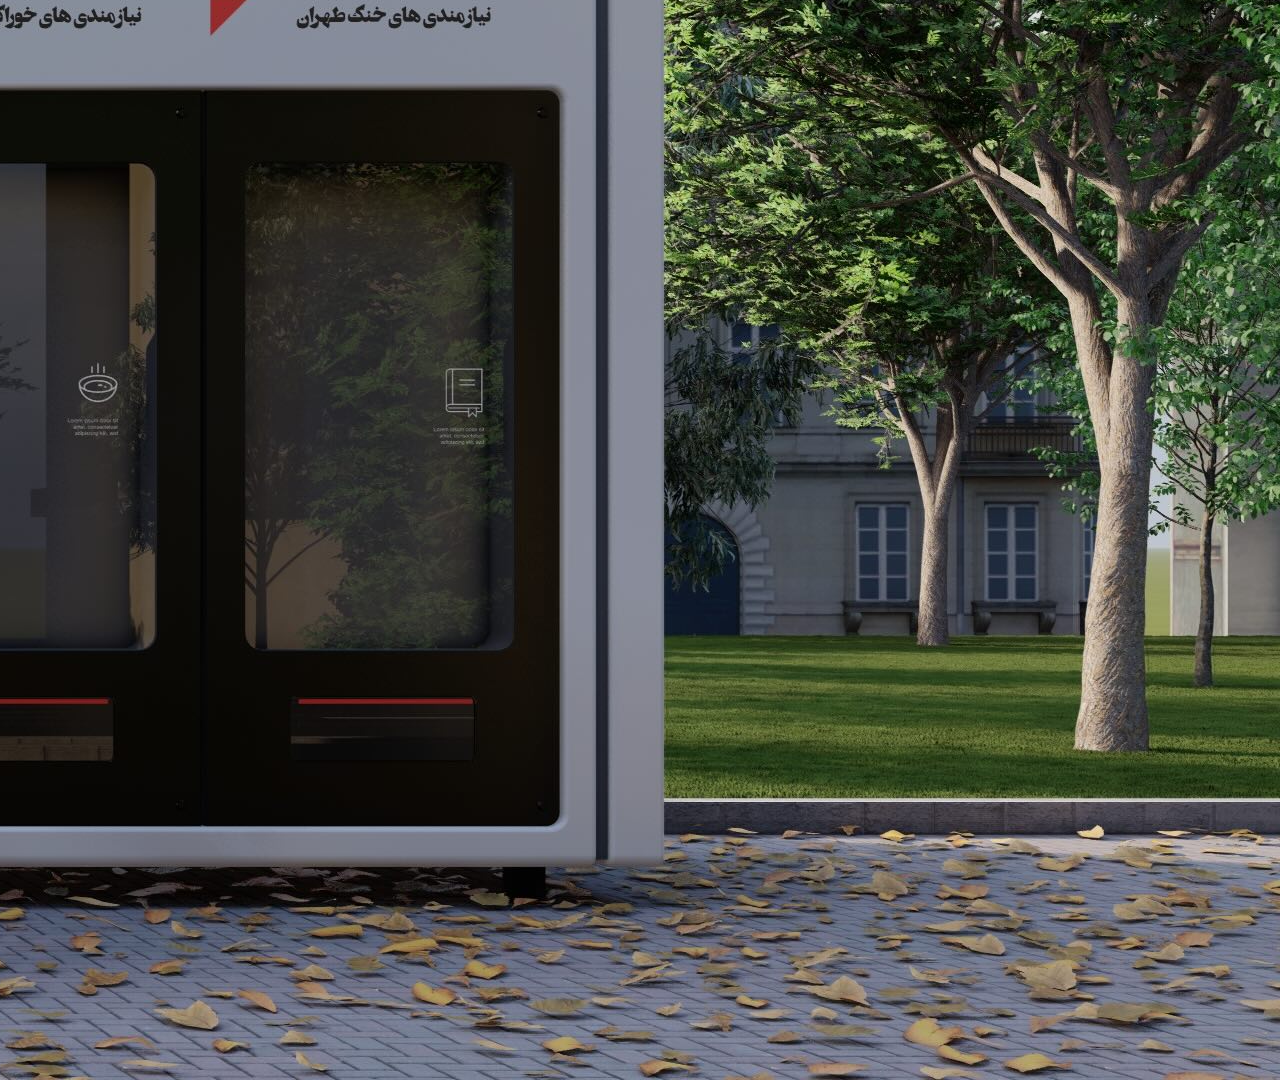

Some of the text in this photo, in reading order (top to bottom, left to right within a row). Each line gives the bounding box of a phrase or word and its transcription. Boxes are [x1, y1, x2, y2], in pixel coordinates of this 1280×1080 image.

[38, 6, 72, 29] های
[296, 6, 346, 29] طهران
[347, 4, 387, 24] خنک
[388, 6, 421, 29] های
